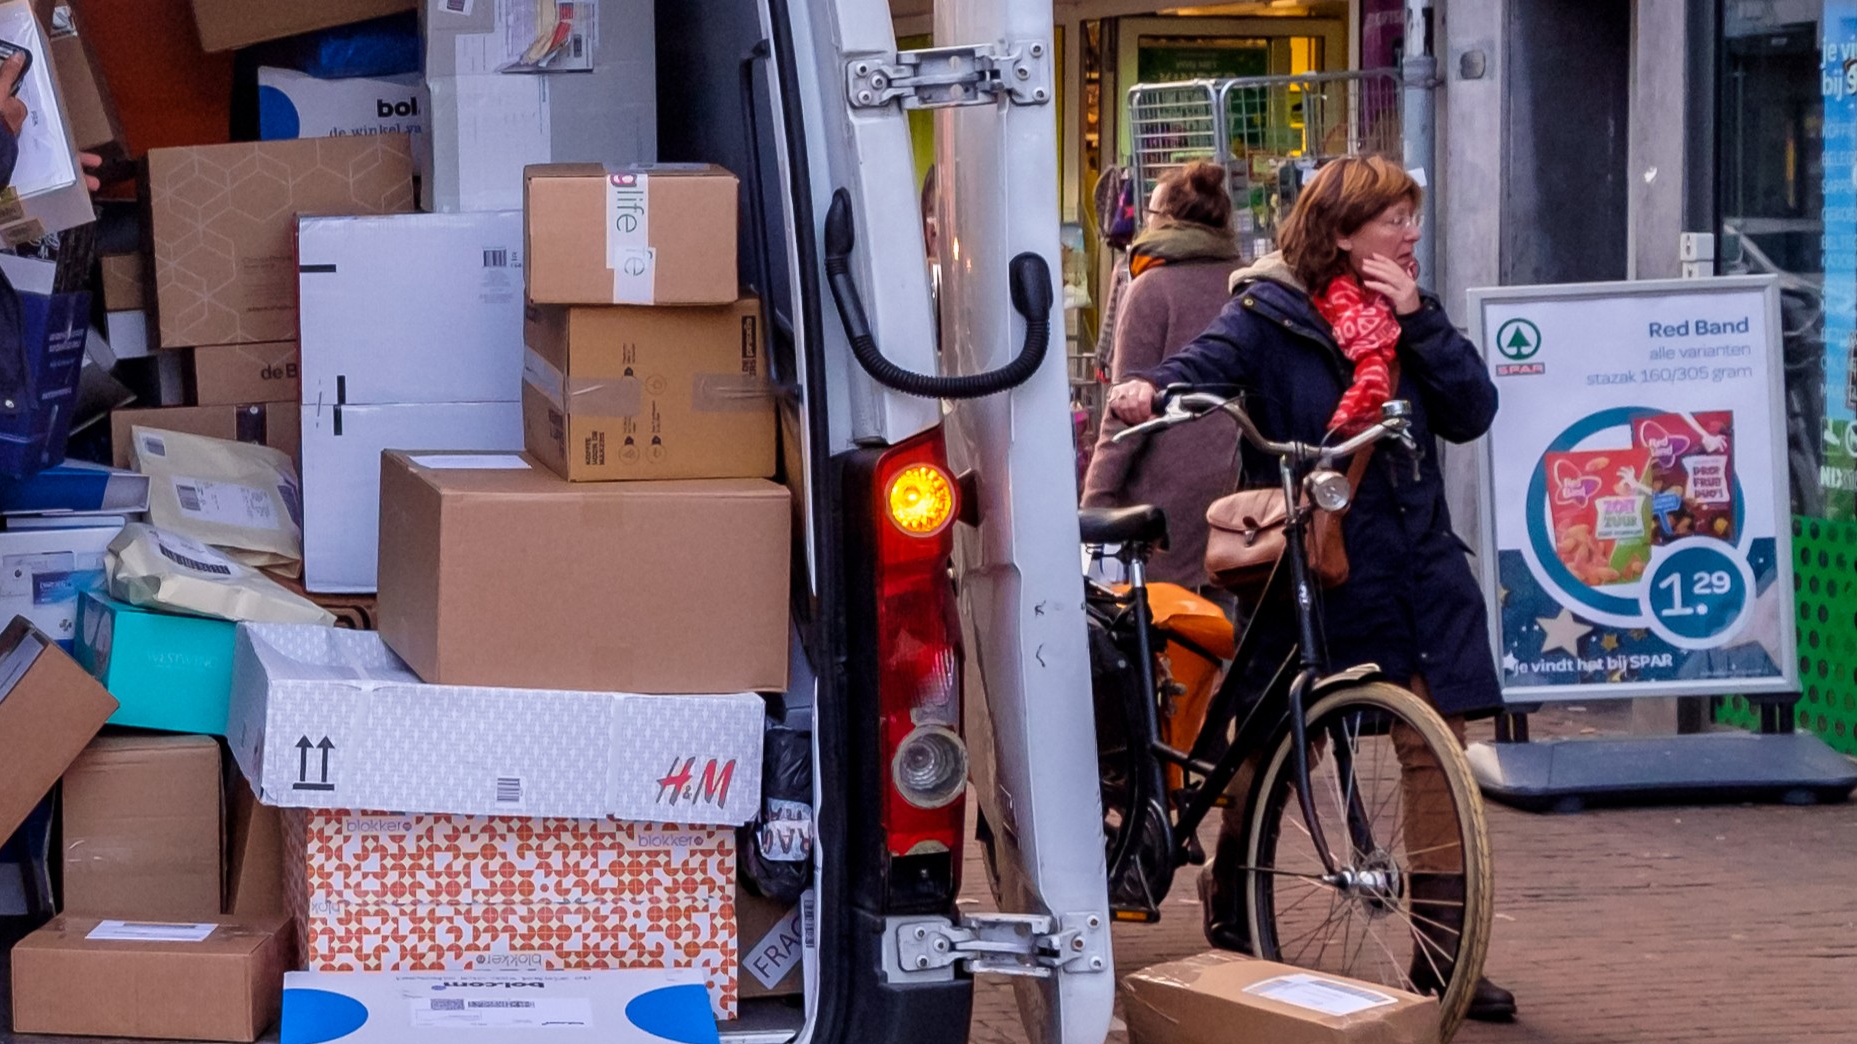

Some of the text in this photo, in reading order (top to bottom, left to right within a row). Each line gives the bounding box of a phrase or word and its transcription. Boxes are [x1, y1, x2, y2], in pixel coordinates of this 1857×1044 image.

[1649, 317, 1750, 338] Red Band
[1650, 344, 1752, 360] alle varianten
[1497, 364, 1544, 375] SPAR
[1586, 366, 1753, 386] stazak 160/305 gram
[1513, 653, 1674, 677] je vindt het bij SPAR
[656, 756, 736, 810] H&M
[346, 819, 402, 832] blokker
[638, 834, 693, 848] blokker
